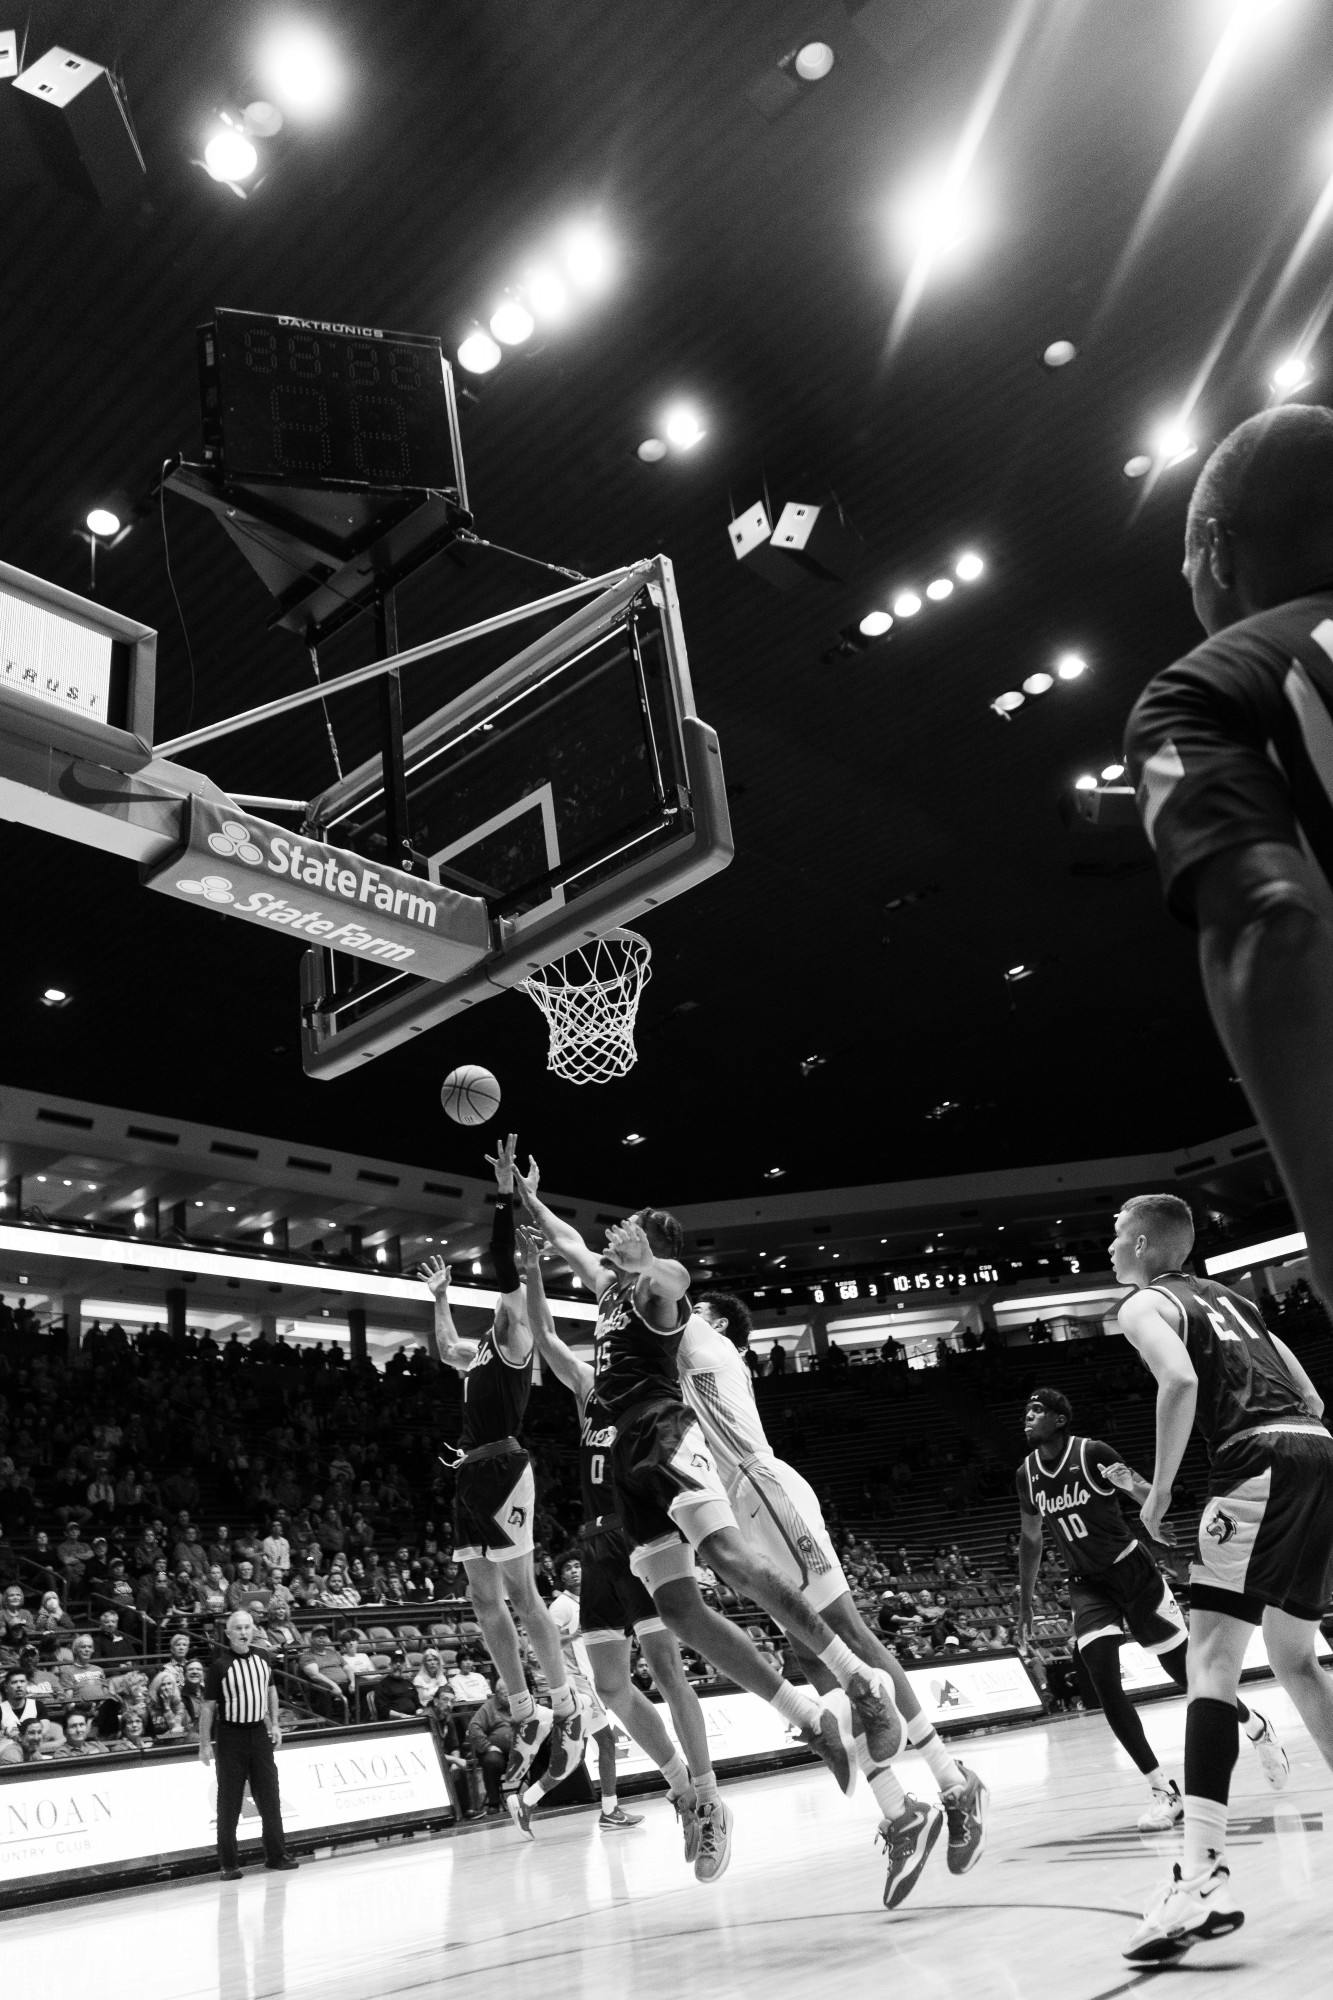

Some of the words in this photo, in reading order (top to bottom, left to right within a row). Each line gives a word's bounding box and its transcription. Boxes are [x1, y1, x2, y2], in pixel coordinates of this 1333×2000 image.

[277, 316, 384, 338] DAKTRONICS
[840, 1285, 858, 1299] 68
[868, 1283, 878, 1297] 3
[893, 1273, 930, 1291] 10:15
[935, 1274, 945, 1288] 2
[957, 1273, 967, 1287] 2
[1070, 1260, 1081, 1274] 2
[1193, 1294, 1260, 1341] 21
[591, 1454, 605, 1484] 0
[1035, 1481, 1091, 1517] Pueblo
[1057, 1513, 1089, 1542] 10
[308, 1748, 428, 1789] TANOAN
[0, 1792, 112, 1836] NOAN
